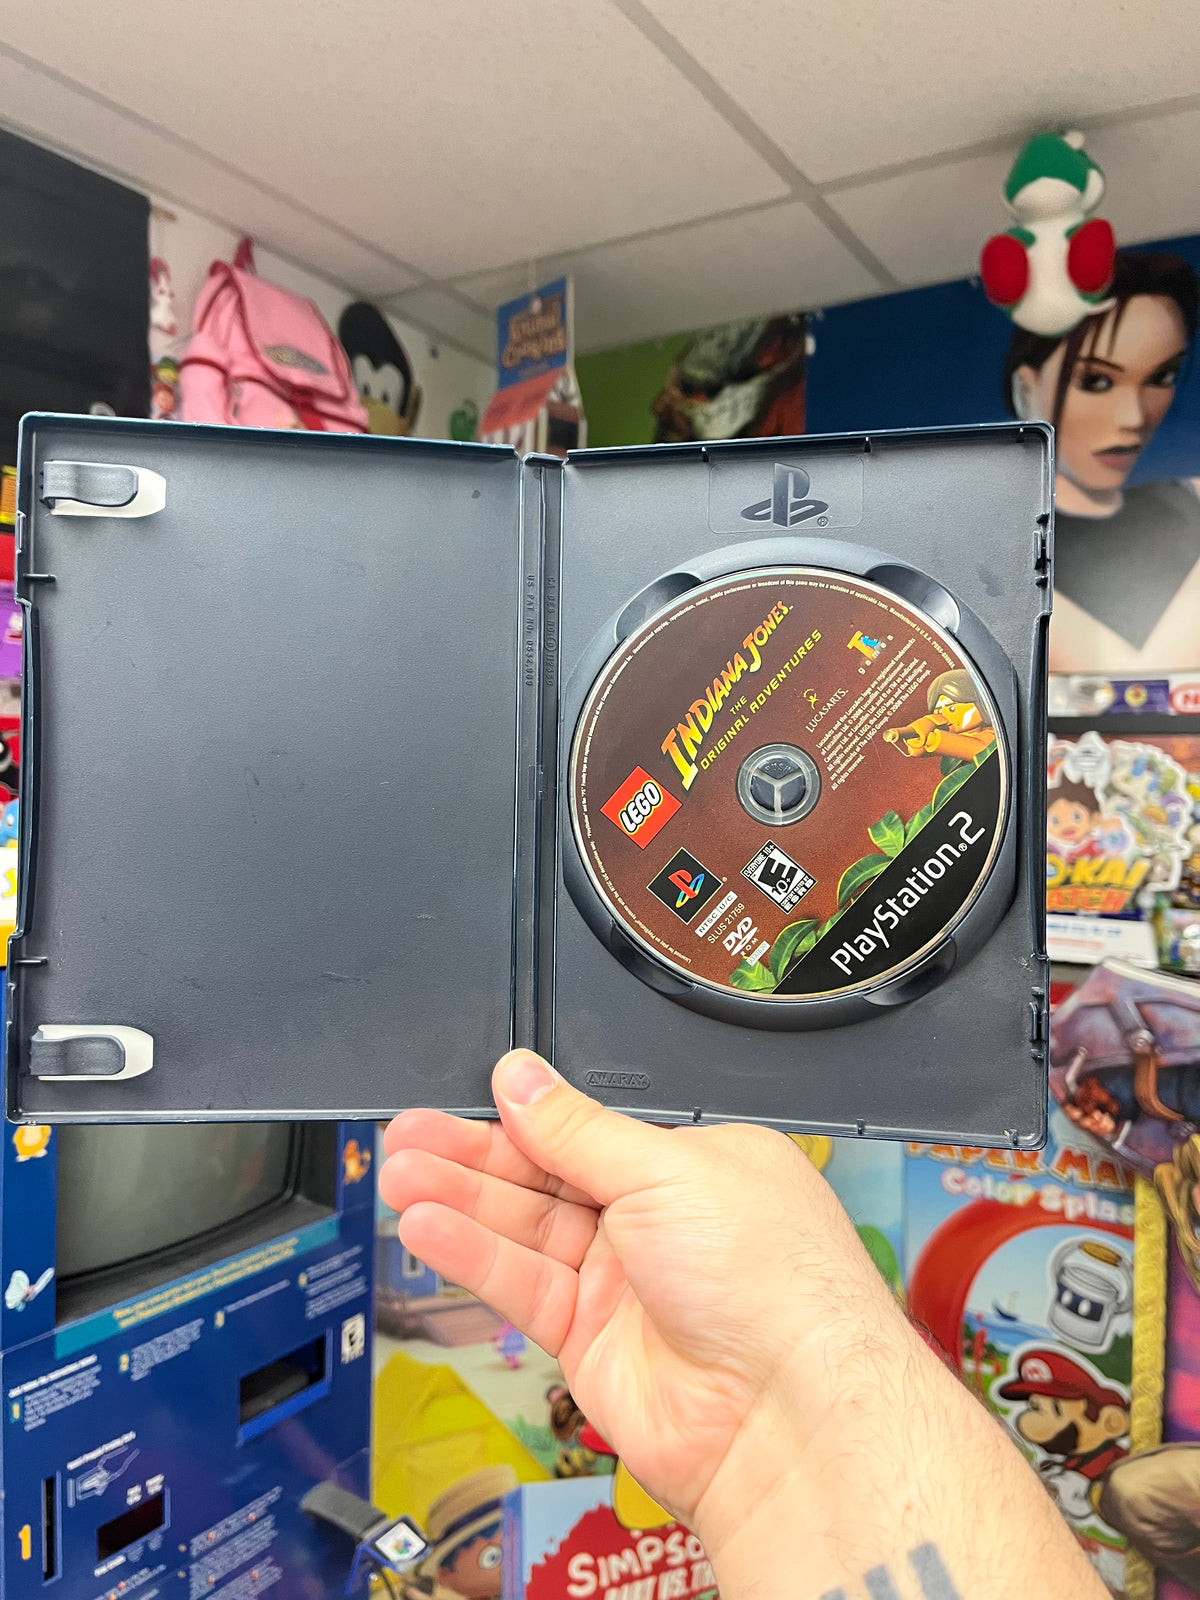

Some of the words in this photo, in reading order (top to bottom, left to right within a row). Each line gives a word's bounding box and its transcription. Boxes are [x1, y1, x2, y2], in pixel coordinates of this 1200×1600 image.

[526, 574, 534, 586] US
[723, 584, 751, 595] performance
[829, 584, 849, 594] violation
[526, 594, 534, 611] PAT
[694, 596, 709, 607] rental,
[709, 591, 723, 600] public
[854, 591, 877, 604] applicable
[876, 601, 889, 611] laws.
[668, 603, 695, 622] reproduction,
[888, 607, 916, 628] Manufactured
[652, 619, 670, 634] copying,
[631, 631, 655, 654] Unauthorized
[609, 659, 628, 684] Entertainment
[600, 683, 613, 701] Computer
[661, 653, 748, 792] INDIANA
[743, 601, 789, 672] JONES
[700, 715, 751, 770] ORIGINAL
[750, 629, 822, 714] ADVENTURES
[815, 727, 834, 748] LucasArts
[831, 720, 841, 730] and
[838, 713, 847, 722] the
[844, 694, 864, 715] LucasArts
[860, 685, 873, 699] logo
[869, 679, 878, 688] are
[874, 659, 897, 682] registered
[892, 636, 916, 662] trademarks
[596, 700, 604, 710] Sony
[730, 696, 748, 715] THE
[823, 730, 843, 751] Lucasfilm
[839, 722, 850, 732] Ltd.
[850, 707, 863, 721] 2008
[860, 688, 880, 710] Lucasfilm
[876, 661, 905, 691] Entertainment
[823, 742, 843, 764] Company
[839, 734, 849, 745] Ltd.
[850, 711, 870, 732] Lucasfilm
[867, 703, 877, 714] Ltd.
[874, 695, 884, 706] and
[888, 680, 898, 690] TM
[899, 656, 920, 678] indicated.
[825, 763, 834, 771] All
[831, 751, 845, 766] rights
[841, 733, 860, 754] reserved.
[857, 722, 871, 736] LEGO,
[867, 715, 877, 725] the
[873, 704, 887, 718] LEGO
[883, 695, 896, 708] logo
[891, 687, 902, 698] and
[899, 680, 908, 690] the
[905, 659, 929, 684] Minifigure
[587, 714, 598, 736] trademarks
[829, 772, 837, 780] are
[834, 749, 857, 774] trademarks
[858, 738, 867, 747] The
[864, 727, 877, 740] LEGO
[874, 713, 890, 730] Group.
[889, 699, 902, 712] 2008
[899, 691, 909, 701] The
[906, 680, 919, 694] LEGO
[916, 667, 932, 684] Group.
[583, 736, 592, 756] registered
[830, 779, 840, 790] All
[835, 770, 850, 785] rights
[845, 752, 865, 773] reserved.
[620, 781, 661, 834] LEGO
[593, 849, 606, 873] designation
[743, 852, 766, 877] EVERYONE
[762, 842, 775, 856] 10+
[606, 879, 616, 892] NTSC
[770, 873, 793, 898] 10+
[783, 878, 814, 911] ESRB
[616, 896, 625, 906] with
[622, 904, 636, 920] systems
[698, 911, 718, 933] NTSC
[718, 894, 733, 909] U/C
[706, 922, 727, 944] SLUS
[724, 902, 745, 924] 21759
[720, 914, 756, 952] DVD
[659, 940, 669, 949] play
[740, 936, 759, 956] ROM
[673, 950, 691, 964] Licensed
[588, 1071, 646, 1087] AMARAY
[941, 1167, 1034, 1206] Color
[18, 1524, 31, 1560] 1
